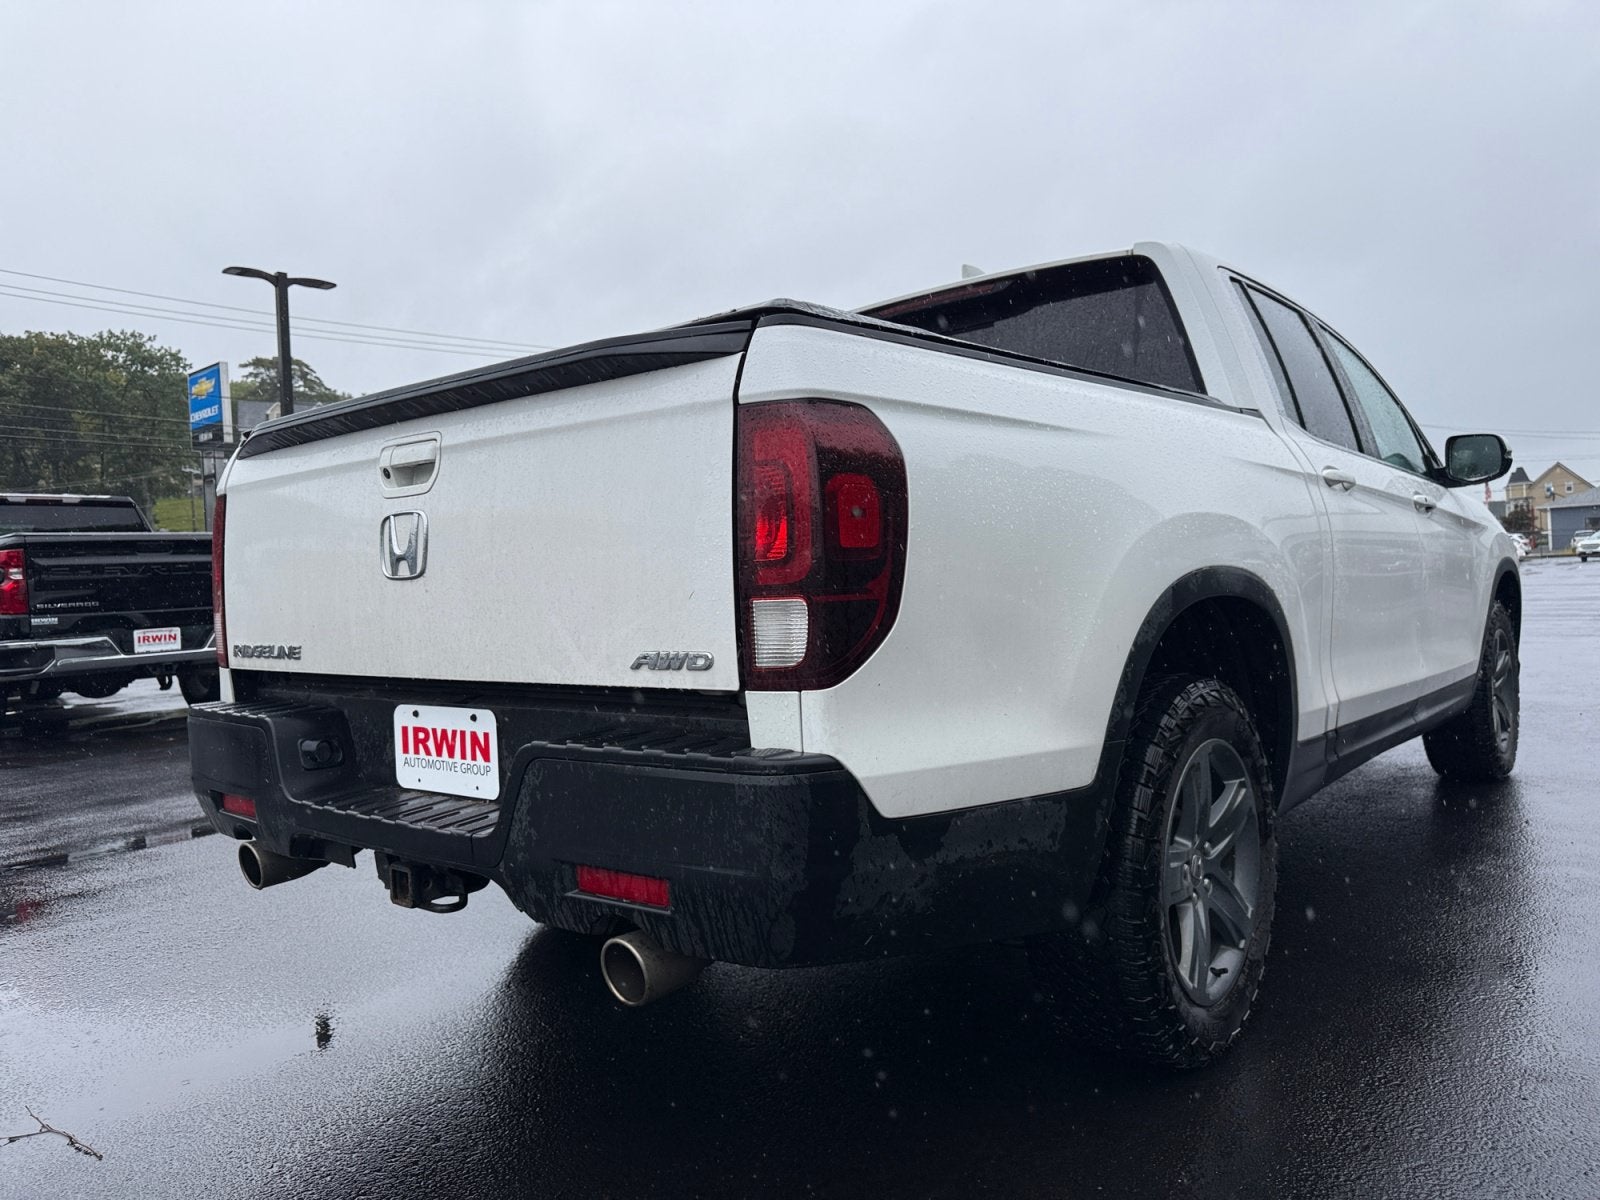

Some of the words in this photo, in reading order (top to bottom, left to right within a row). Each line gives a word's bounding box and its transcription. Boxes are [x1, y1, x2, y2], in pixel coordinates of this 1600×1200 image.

[36, 601, 100, 610] SILVERADO
[137, 633, 177, 644] IRWIN
[233, 644, 302, 660] RIDGELINE
[630, 651, 715, 671] AWD
[401, 725, 491, 763] IRWIN
[403, 756, 459, 773] AUTOMOTIVE
[460, 762, 492, 776] GROUP
